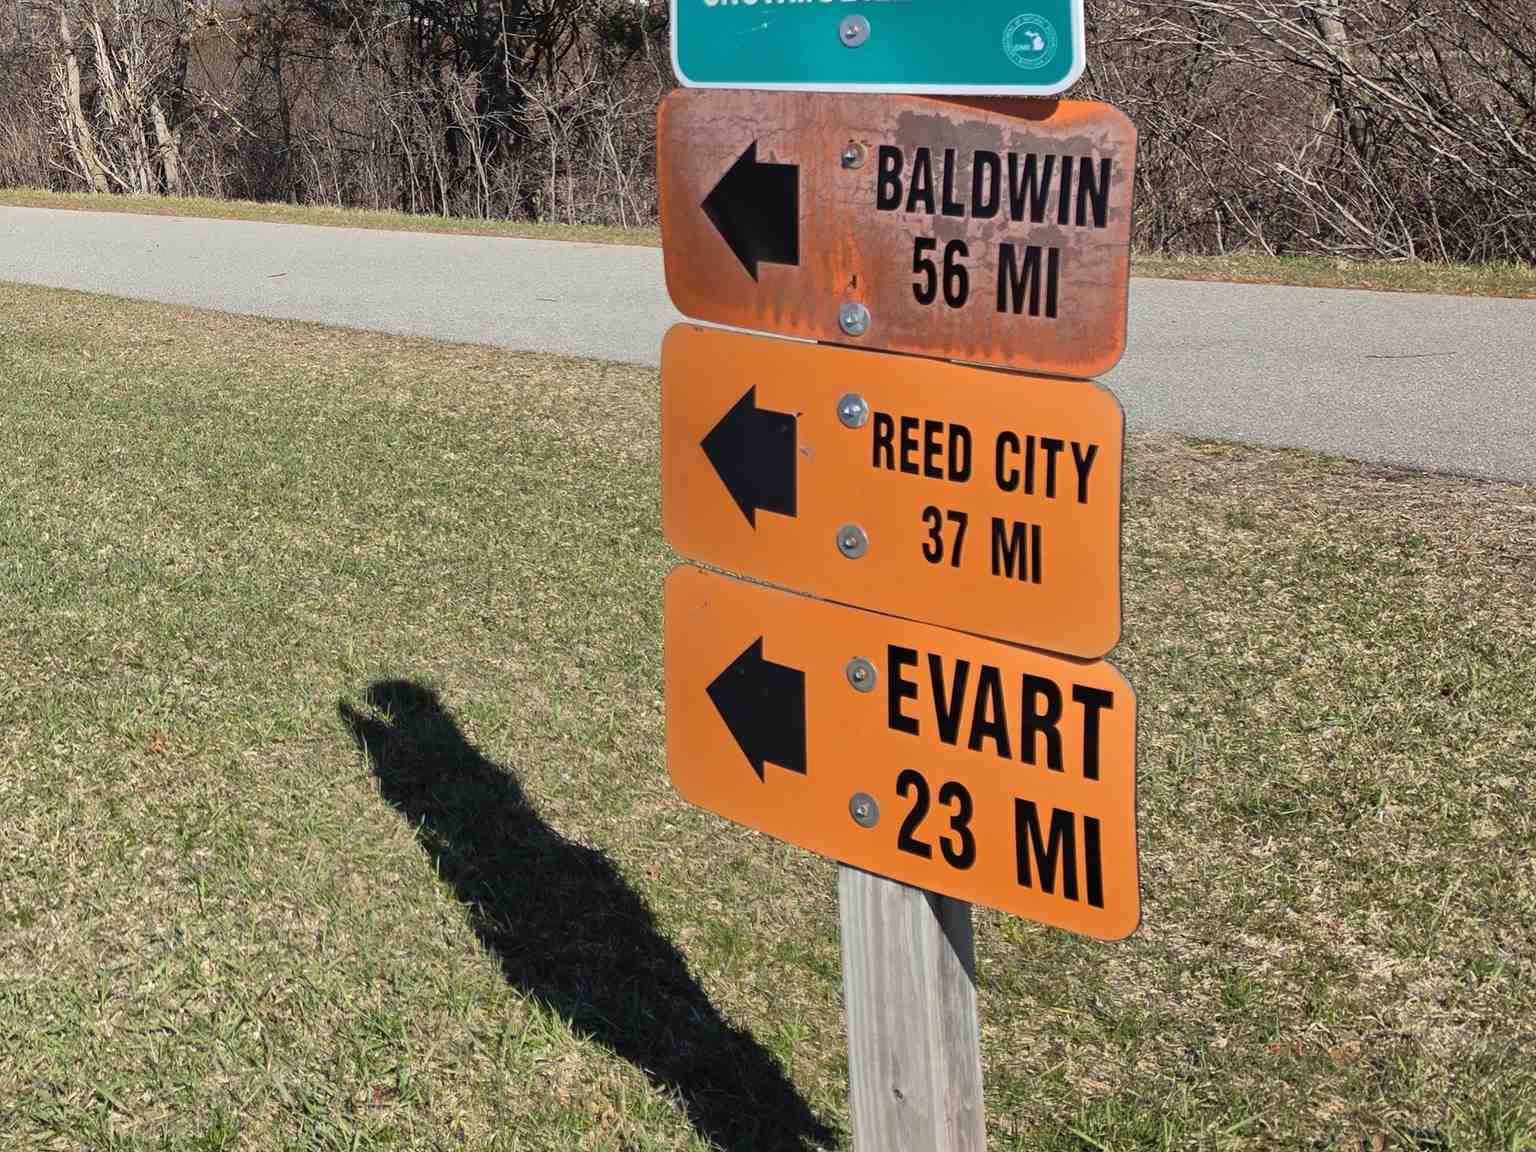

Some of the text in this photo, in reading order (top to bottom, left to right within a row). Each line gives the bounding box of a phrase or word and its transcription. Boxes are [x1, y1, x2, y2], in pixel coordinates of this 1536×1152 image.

[876, 145, 1113, 228] BALDWIN
[912, 237, 1059, 319] 56 MI
[872, 412, 1098, 504] REED CITY
[921, 506, 1041, 584] 37 MI
[887, 644, 1114, 781] EVART
[895, 769, 1105, 909] 23 MI
